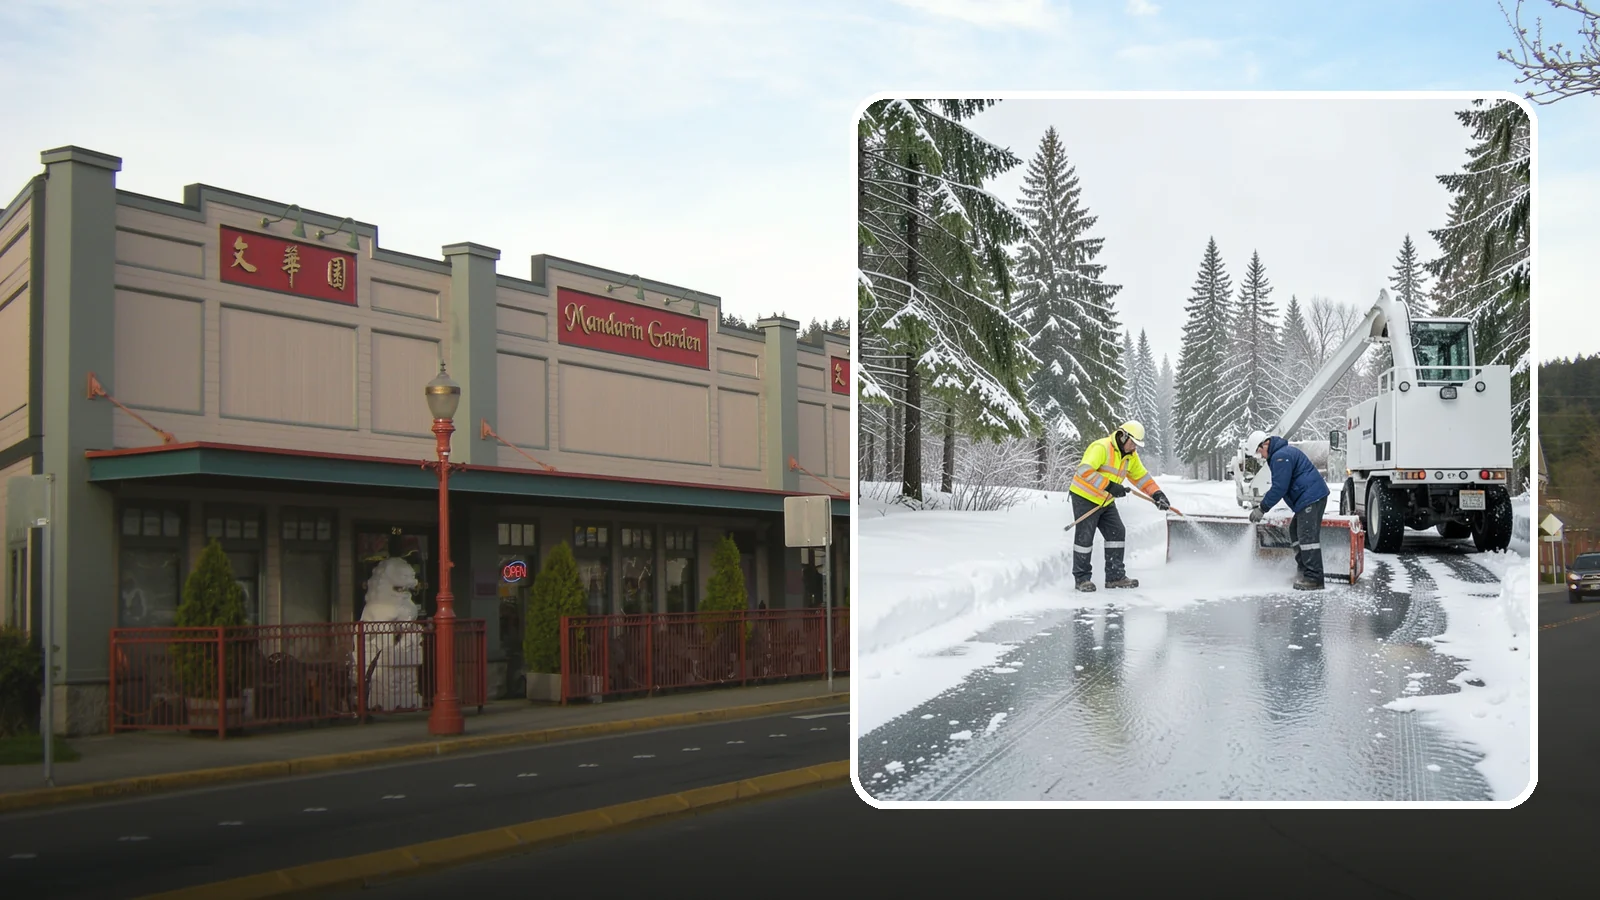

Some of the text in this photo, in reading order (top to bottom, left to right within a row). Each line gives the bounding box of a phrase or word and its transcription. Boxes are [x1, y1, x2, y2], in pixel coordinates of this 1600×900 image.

[230, 235, 346, 291] 文華園
[564, 302, 701, 352] Mandarin Garden
[503, 565, 527, 578] OPEN
